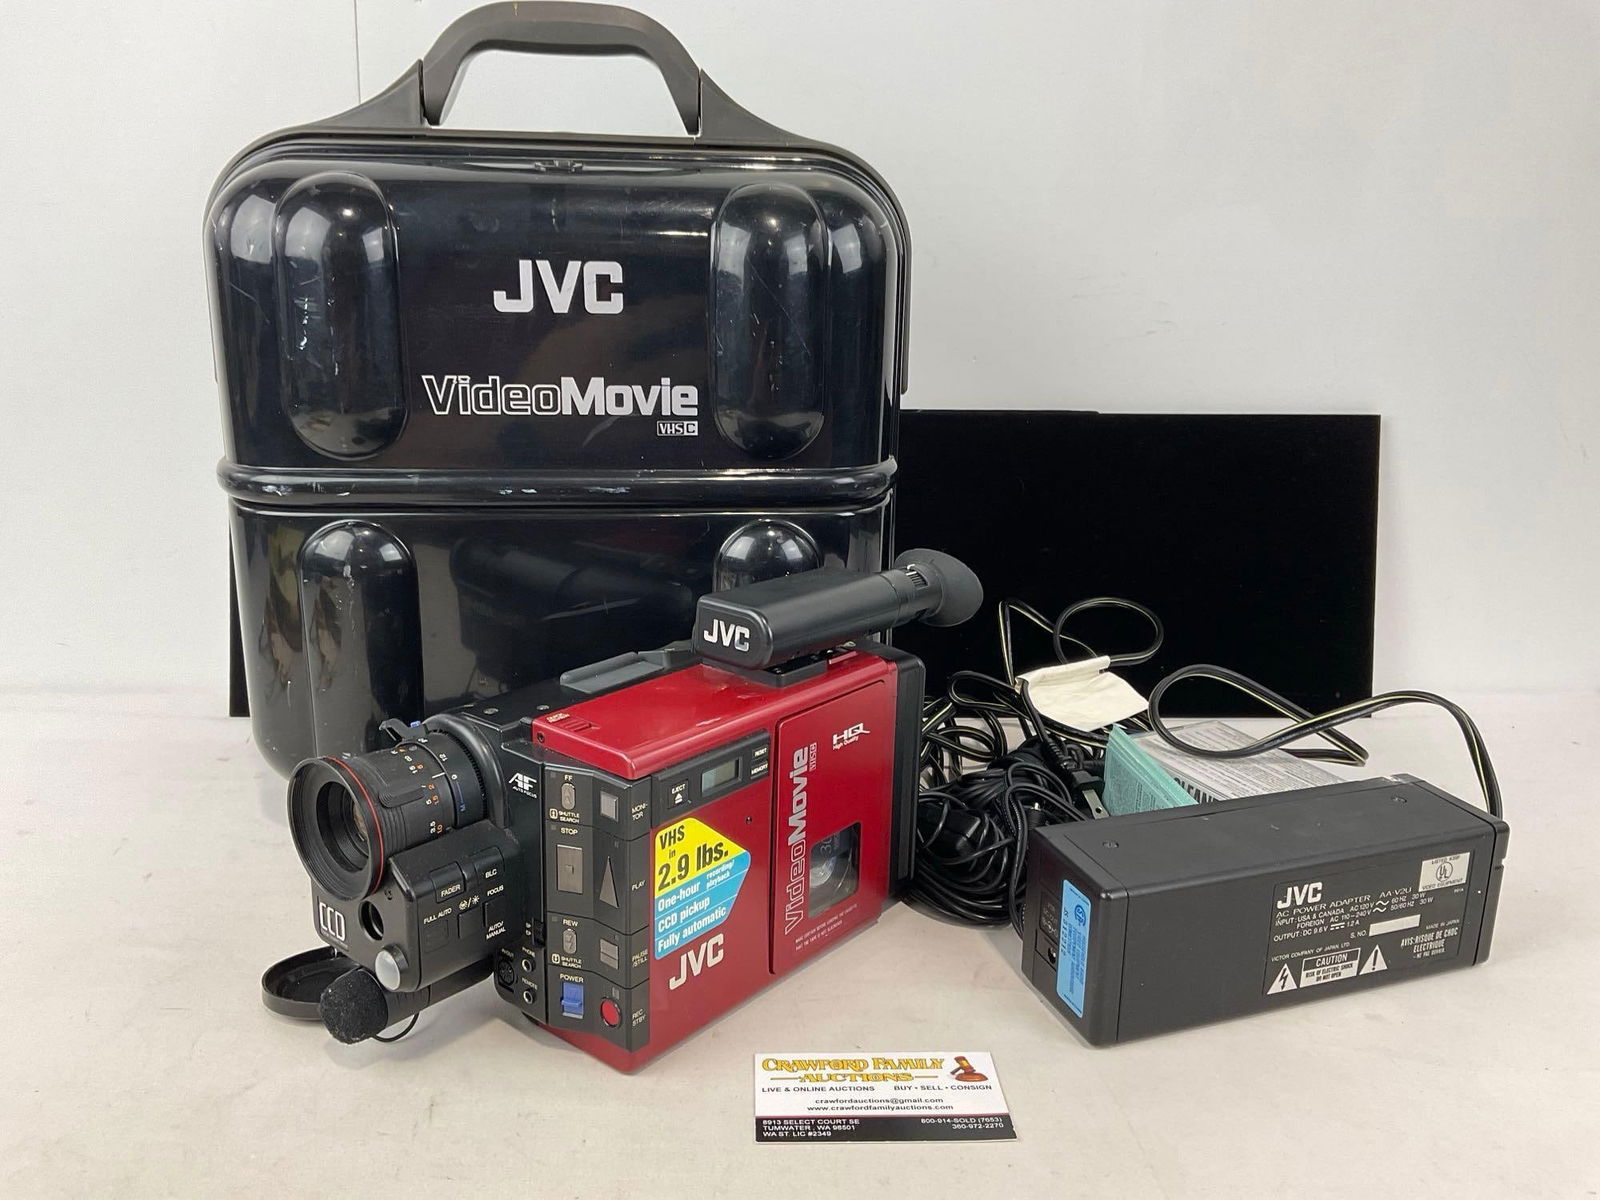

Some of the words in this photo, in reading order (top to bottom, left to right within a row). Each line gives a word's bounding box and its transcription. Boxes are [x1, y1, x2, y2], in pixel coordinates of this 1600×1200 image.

[493, 259, 624, 315] JVC
[421, 375, 698, 416] VideoMovie
[703, 618, 750, 652] JVC
[832, 723, 870, 745] HQ
[754, 747, 768, 757] RESET
[750, 763, 769, 775] MEMORY
[508, 772, 538, 791] AF
[524, 789, 538, 799] FOCUS
[671, 783, 686, 795] EJECT
[558, 810, 580, 819] SHUTTLE
[559, 816, 580, 824] SEARCH
[632, 812, 644, 821] TOR
[560, 827, 579, 836] STOP
[659, 824, 686, 850] VHS
[668, 848, 676, 860] in
[658, 853, 690, 891] 2.9
[696, 841, 729, 871] lbs.
[485, 868, 498, 879] BLC
[631, 880, 646, 891] PLAY
[706, 872, 731, 890] playback
[440, 884, 461, 897] FADER
[487, 885, 504, 896] FOCUS
[658, 881, 701, 912] One-hour
[1277, 882, 1323, 909] JVC
[1276, 911, 1290, 919] AC
[1293, 903, 1327, 916] POWER
[1329, 894, 1371, 909] ADAPTER
[423, 914, 437, 924] FULL
[437, 908, 452, 919] AUTO
[658, 912, 678, 933] CCD
[680, 896, 711, 923] pickup
[1297, 914, 1311, 923] USA
[1318, 908, 1345, 919] CANADA
[320, 902, 346, 941] CCD
[562, 919, 579, 927] REW
[1296, 919, 1325, 929] FOREIGN
[1330, 915, 1339, 923] AC
[486, 926, 506, 940] MANUAL
[658, 931, 681, 953] Fully
[682, 906, 727, 939] automatic
[1435, 930, 1443, 940] DE
[560, 956, 582, 965] SHUTTLE
[631, 949, 649, 962] PAUSE
[669, 933, 724, 990] JVC
[1271, 954, 1290, 962] VICTOR
[1290, 949, 1315, 959] COMPANY
[1316, 953, 1348, 967] CAUTION
[561, 961, 582, 969] SEARCH
[560, 973, 584, 983] POWER
[632, 1008, 644, 1019] REC
[632, 1014, 646, 1027] STBY
[762, 1058, 869, 1073] CRAWFORD
[872, 1057, 945, 1071] FAMILY
[800, 1073, 914, 1083] AUCTIONS
[807, 1103, 954, 1112] www.crawfordfamilyauctions.com
[815, 1097, 944, 1105] crawfordauctions@gmail.com
